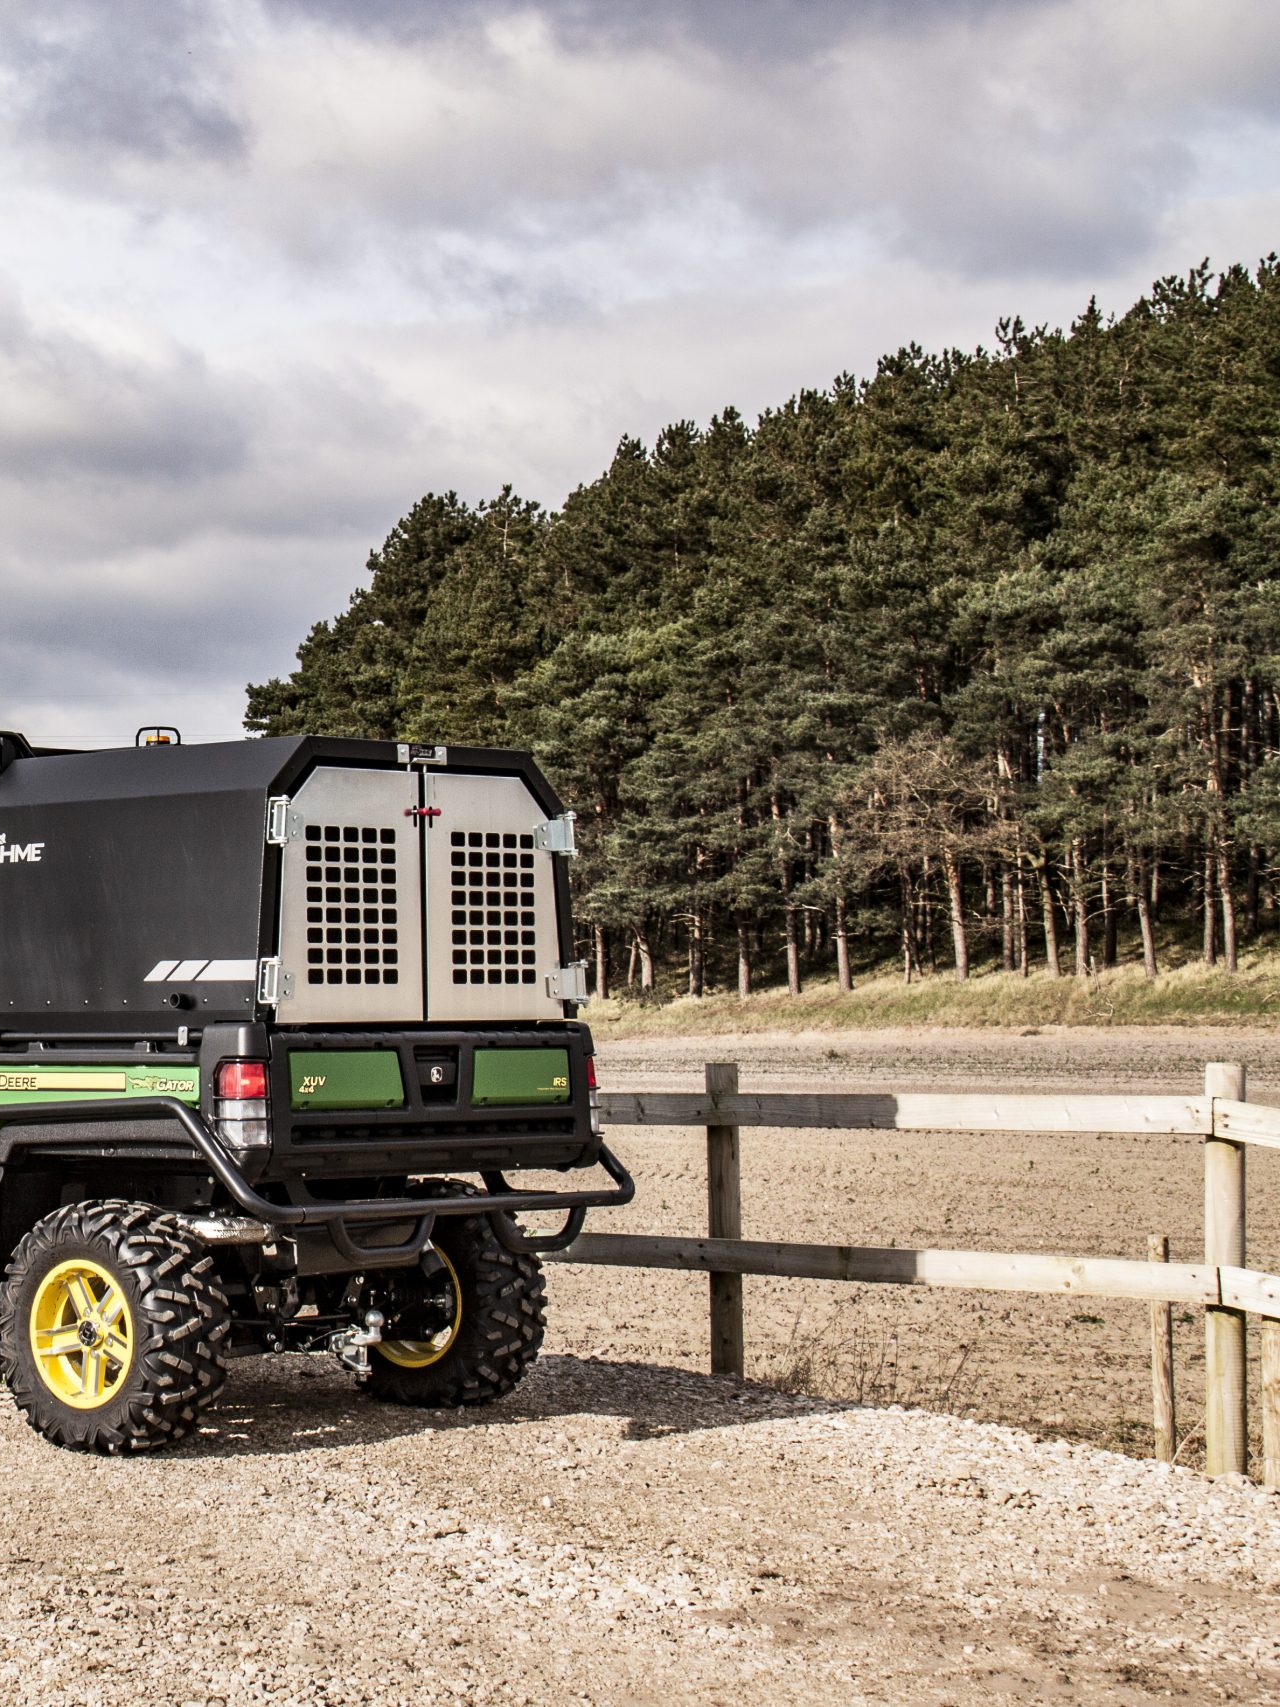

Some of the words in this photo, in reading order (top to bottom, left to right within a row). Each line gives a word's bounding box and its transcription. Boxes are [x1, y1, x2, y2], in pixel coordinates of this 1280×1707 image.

[156, 1079, 194, 1092] GATOR
[303, 1076, 326, 1086] XUV
[553, 1077, 567, 1087] IRS
